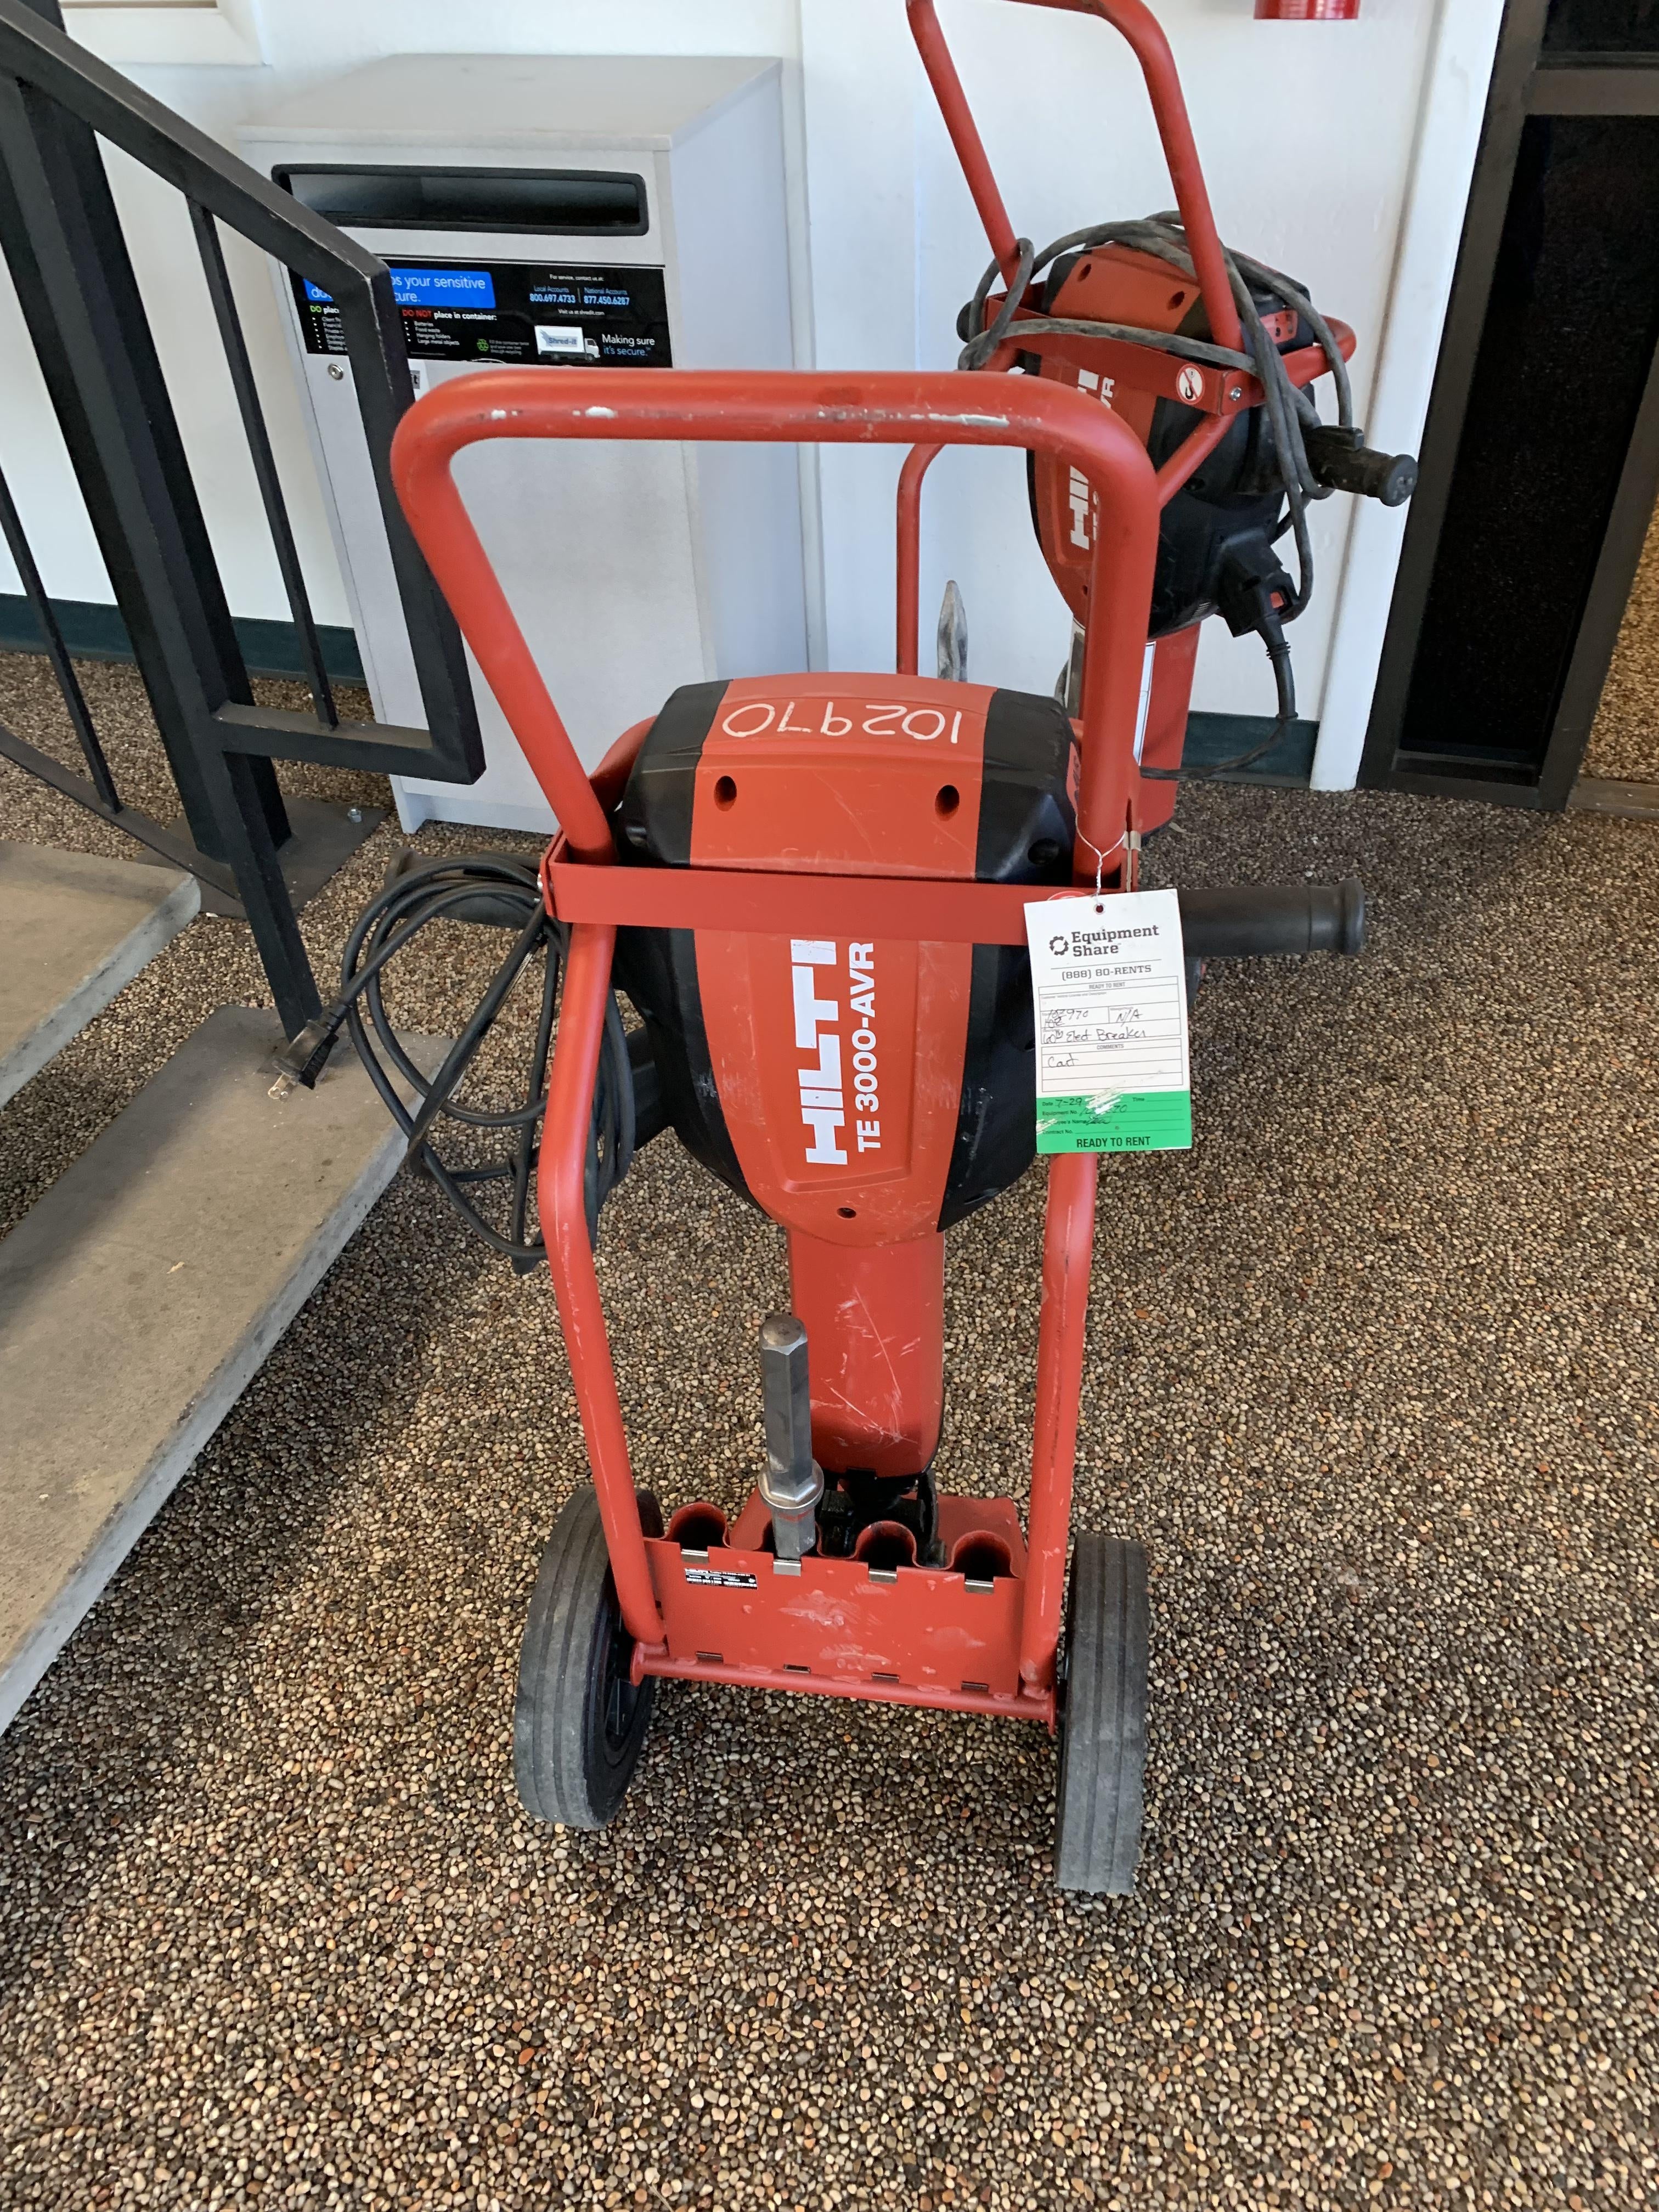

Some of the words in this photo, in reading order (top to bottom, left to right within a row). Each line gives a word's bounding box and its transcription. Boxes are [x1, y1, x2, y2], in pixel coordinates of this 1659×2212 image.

[404, 277, 431, 289] your
[434, 275, 486, 289] sensitive
[529, 294, 575, 303] 800.697.4733
[584, 296, 630, 306] 877.450.6287
[434, 311, 453, 319] place
[602, 334, 634, 347] Making
[722, 702, 961, 744] 102970
[1071, 925, 1159, 944] Equipment
[1073, 944, 1119, 957] Share
[1062, 970, 1091, 981] (888)
[1096, 964, 1152, 977] 80-RENTS
[1115, 1008, 1142, 1027] N/A
[849, 942, 879, 1112] 3000-AVR
[791, 939, 847, 1165] HILTI
[856, 1120, 881, 1152] TE
[1076, 1138, 1108, 1148] READY
[1110, 1137, 1122, 1146] TO
[1126, 1136, 1151, 1146] RENT
